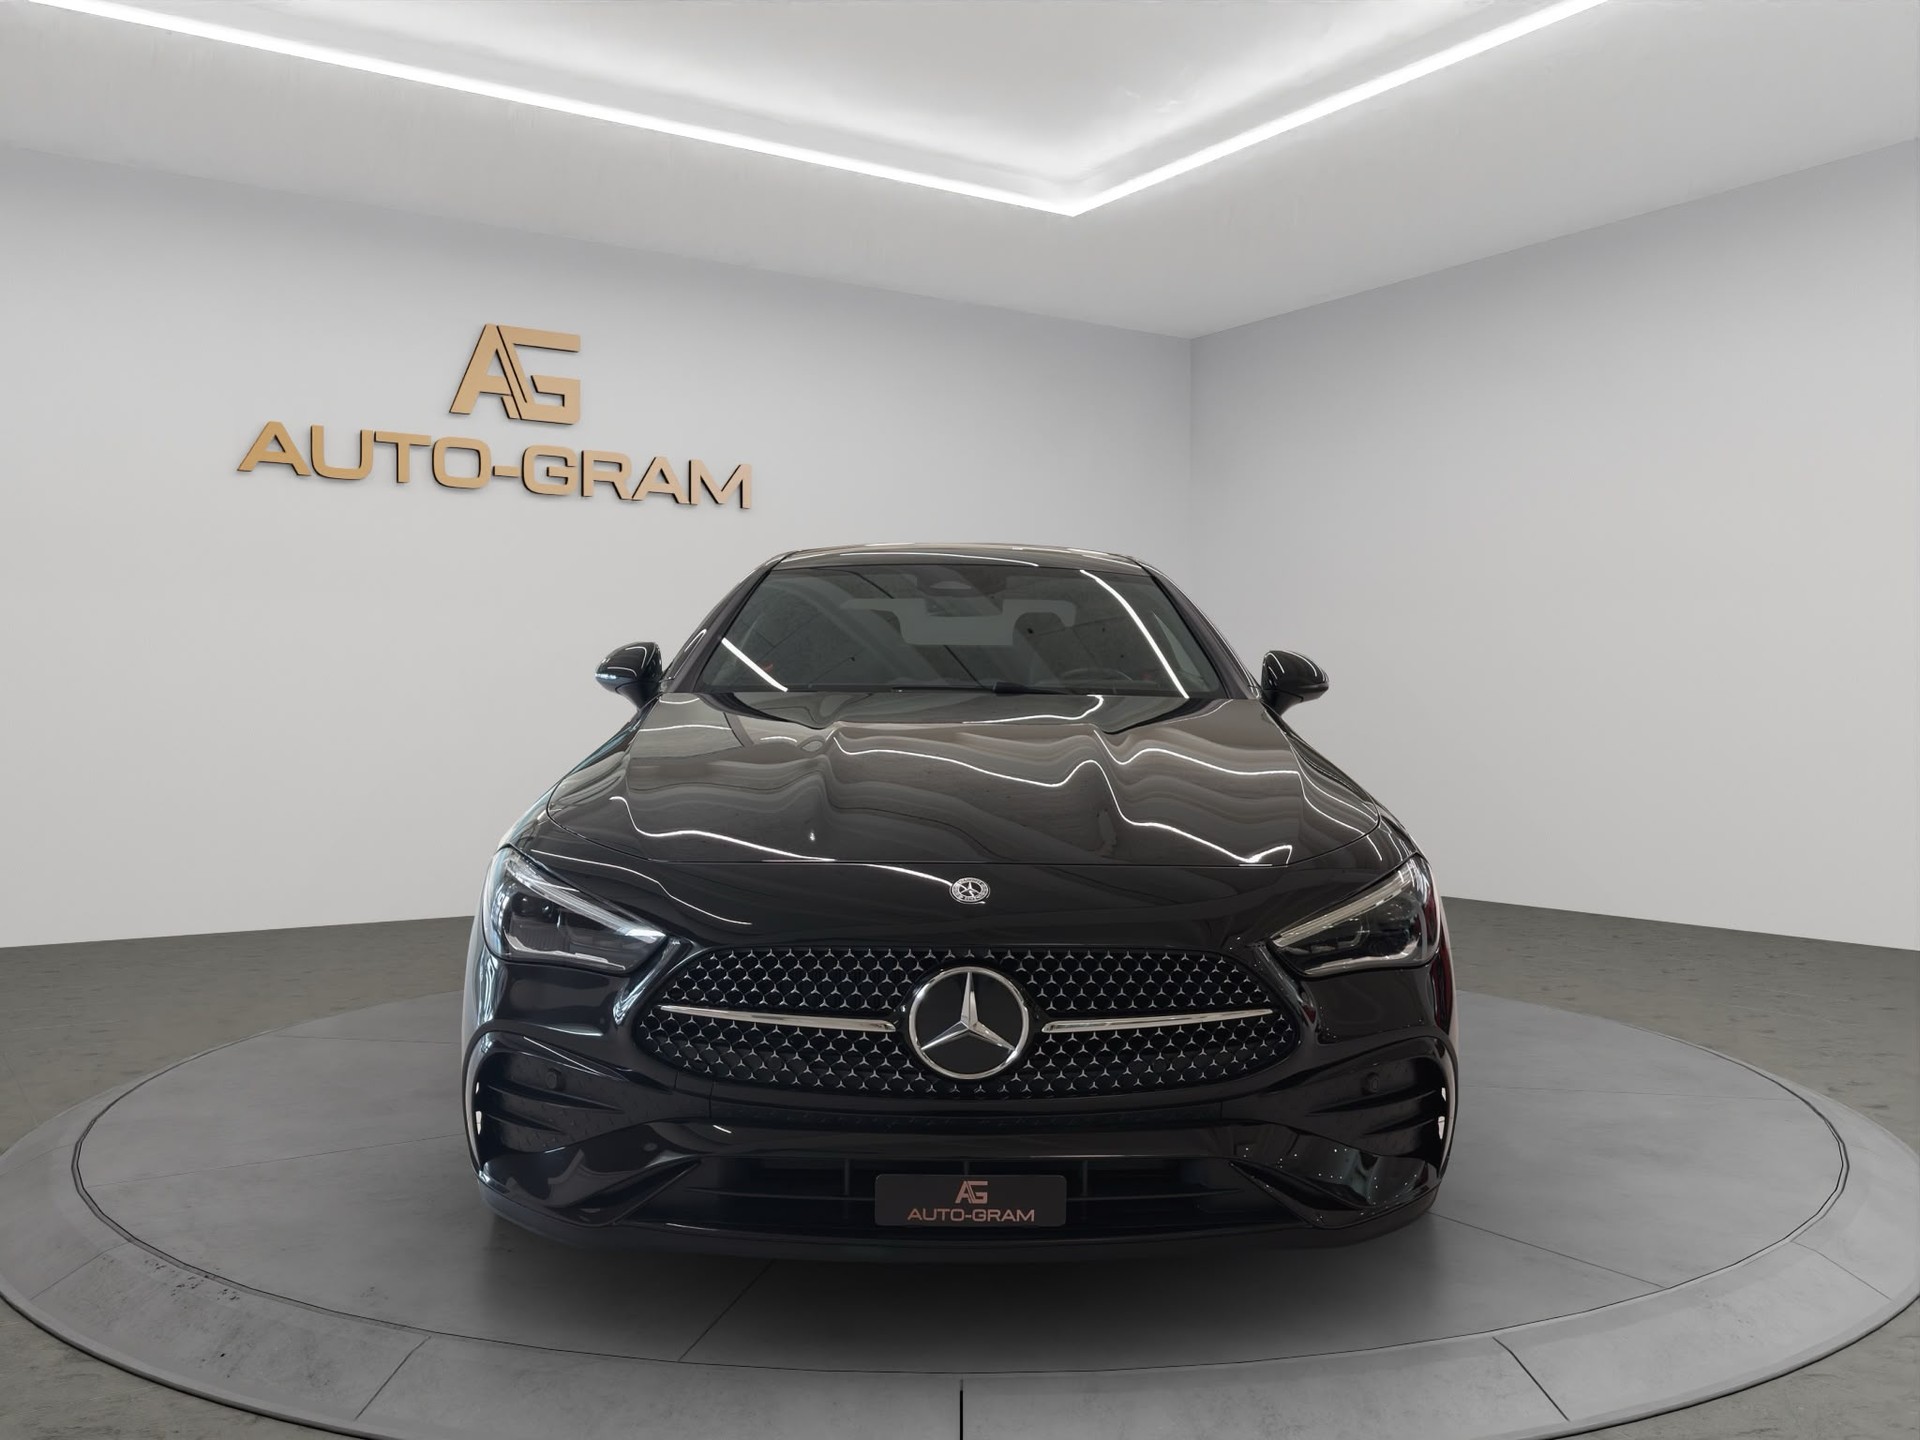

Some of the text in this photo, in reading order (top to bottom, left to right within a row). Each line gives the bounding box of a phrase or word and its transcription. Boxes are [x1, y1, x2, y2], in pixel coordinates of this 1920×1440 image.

[449, 323, 581, 425] AG
[237, 421, 752, 510] AUTO-GRAM
[907, 1208, 1035, 1222] AUTO-GRAM
[955, 1180, 988, 1204] AG
